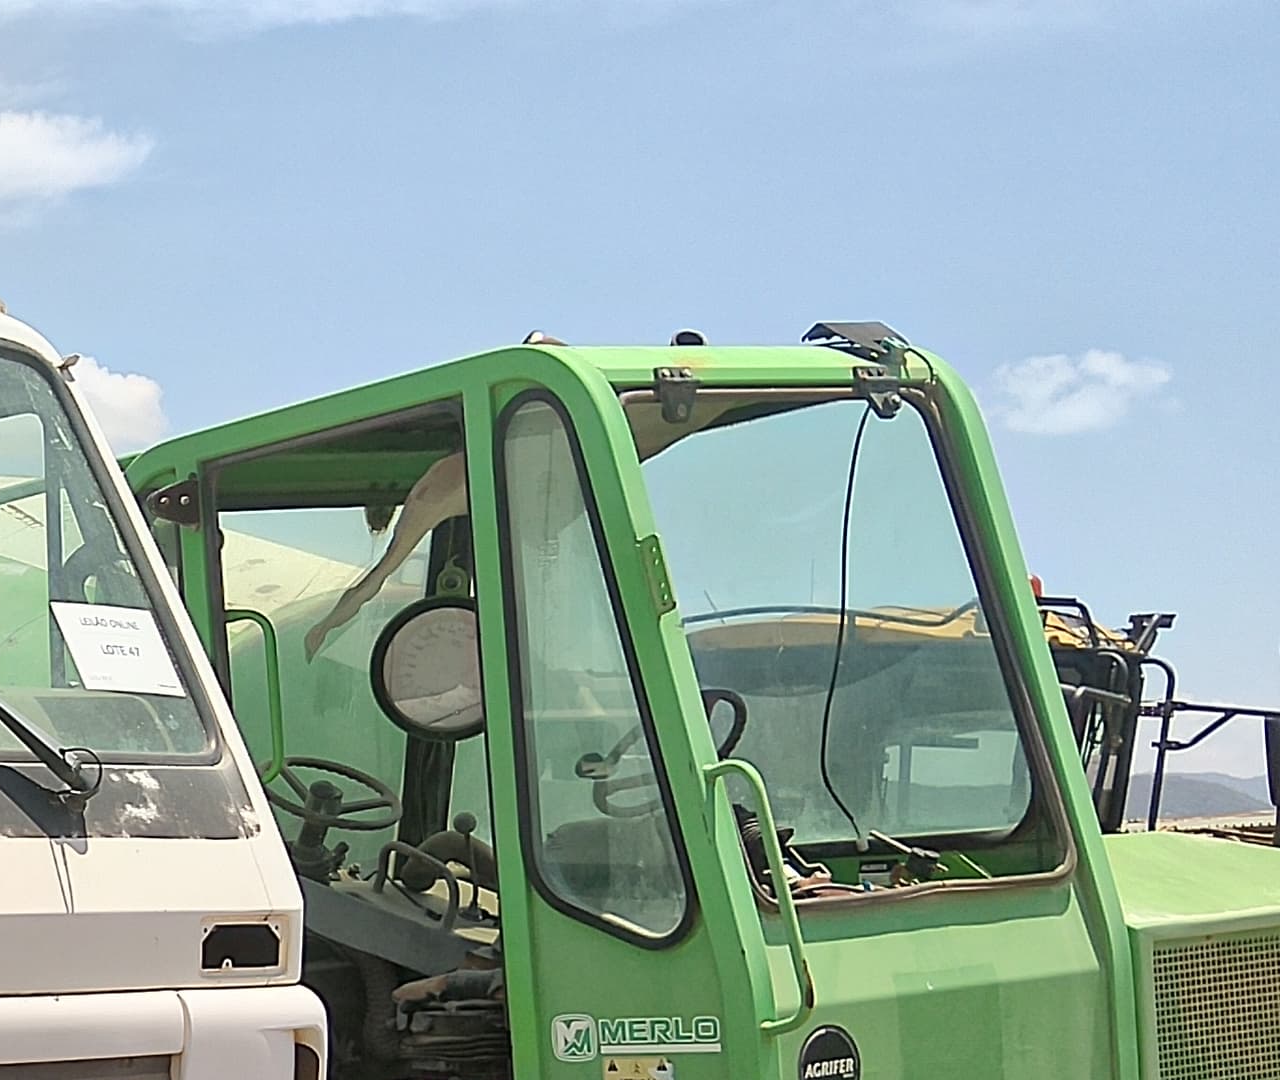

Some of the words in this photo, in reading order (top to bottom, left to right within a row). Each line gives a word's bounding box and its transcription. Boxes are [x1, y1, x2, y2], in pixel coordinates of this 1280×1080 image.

[100, 644, 128, 656] LOTE
[598, 1016, 721, 1046] MERLO
[804, 1057, 854, 1080] AGRIFER
